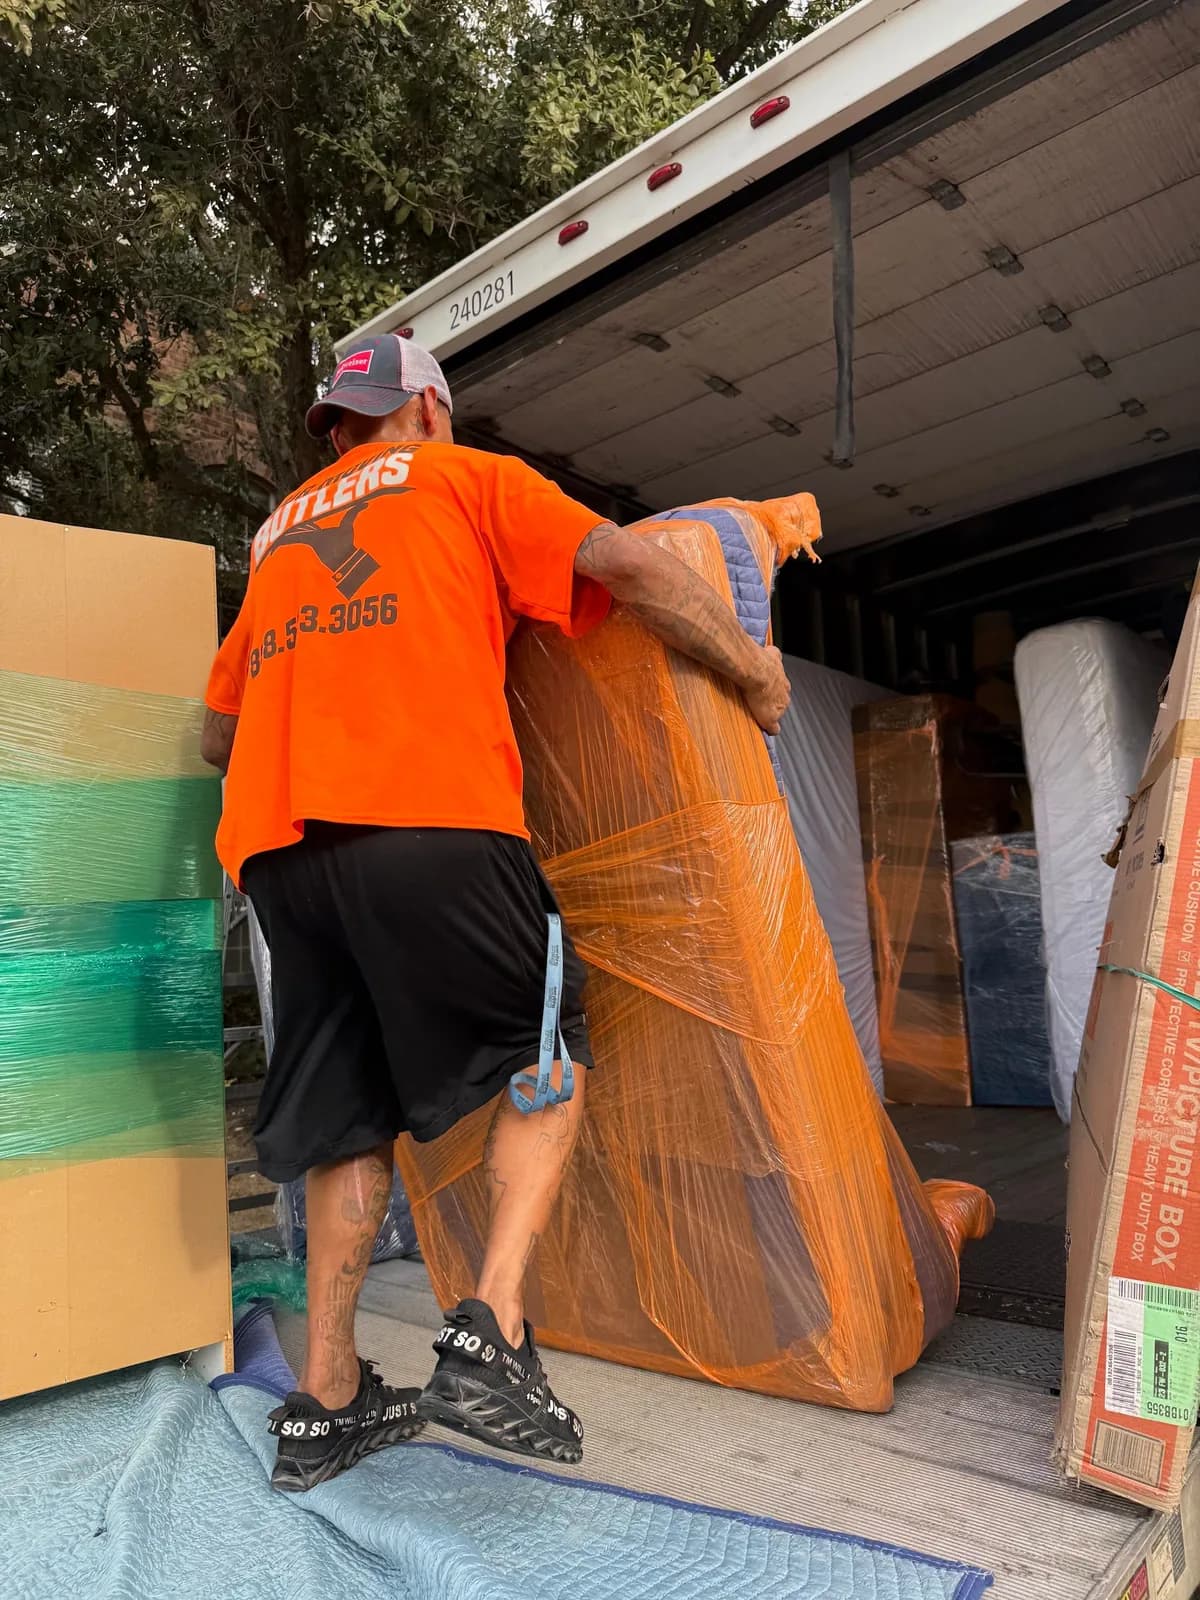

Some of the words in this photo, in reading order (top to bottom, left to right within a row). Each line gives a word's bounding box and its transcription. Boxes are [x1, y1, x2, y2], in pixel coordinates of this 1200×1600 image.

[450, 270, 514, 331] 240281
[253, 452, 414, 565] BUTLERS
[1181, 881, 1200, 943] CUSHION
[1153, 1058, 1174, 1123] CORNERS
[1144, 1143, 1161, 1190] HEAVY
[1138, 1192, 1153, 1234] DUTY
[1131, 1232, 1146, 1262] BOX
[1151, 1203, 1184, 1271] BOX
[453, 1331, 481, 1351] SO
[1174, 1325, 1188, 1343] 016
[281, 1421, 306, 1437] SO
[309, 1421, 330, 1437] SO
[382, 1402, 408, 1421] JUST
[410, 1402, 417, 1415] S
